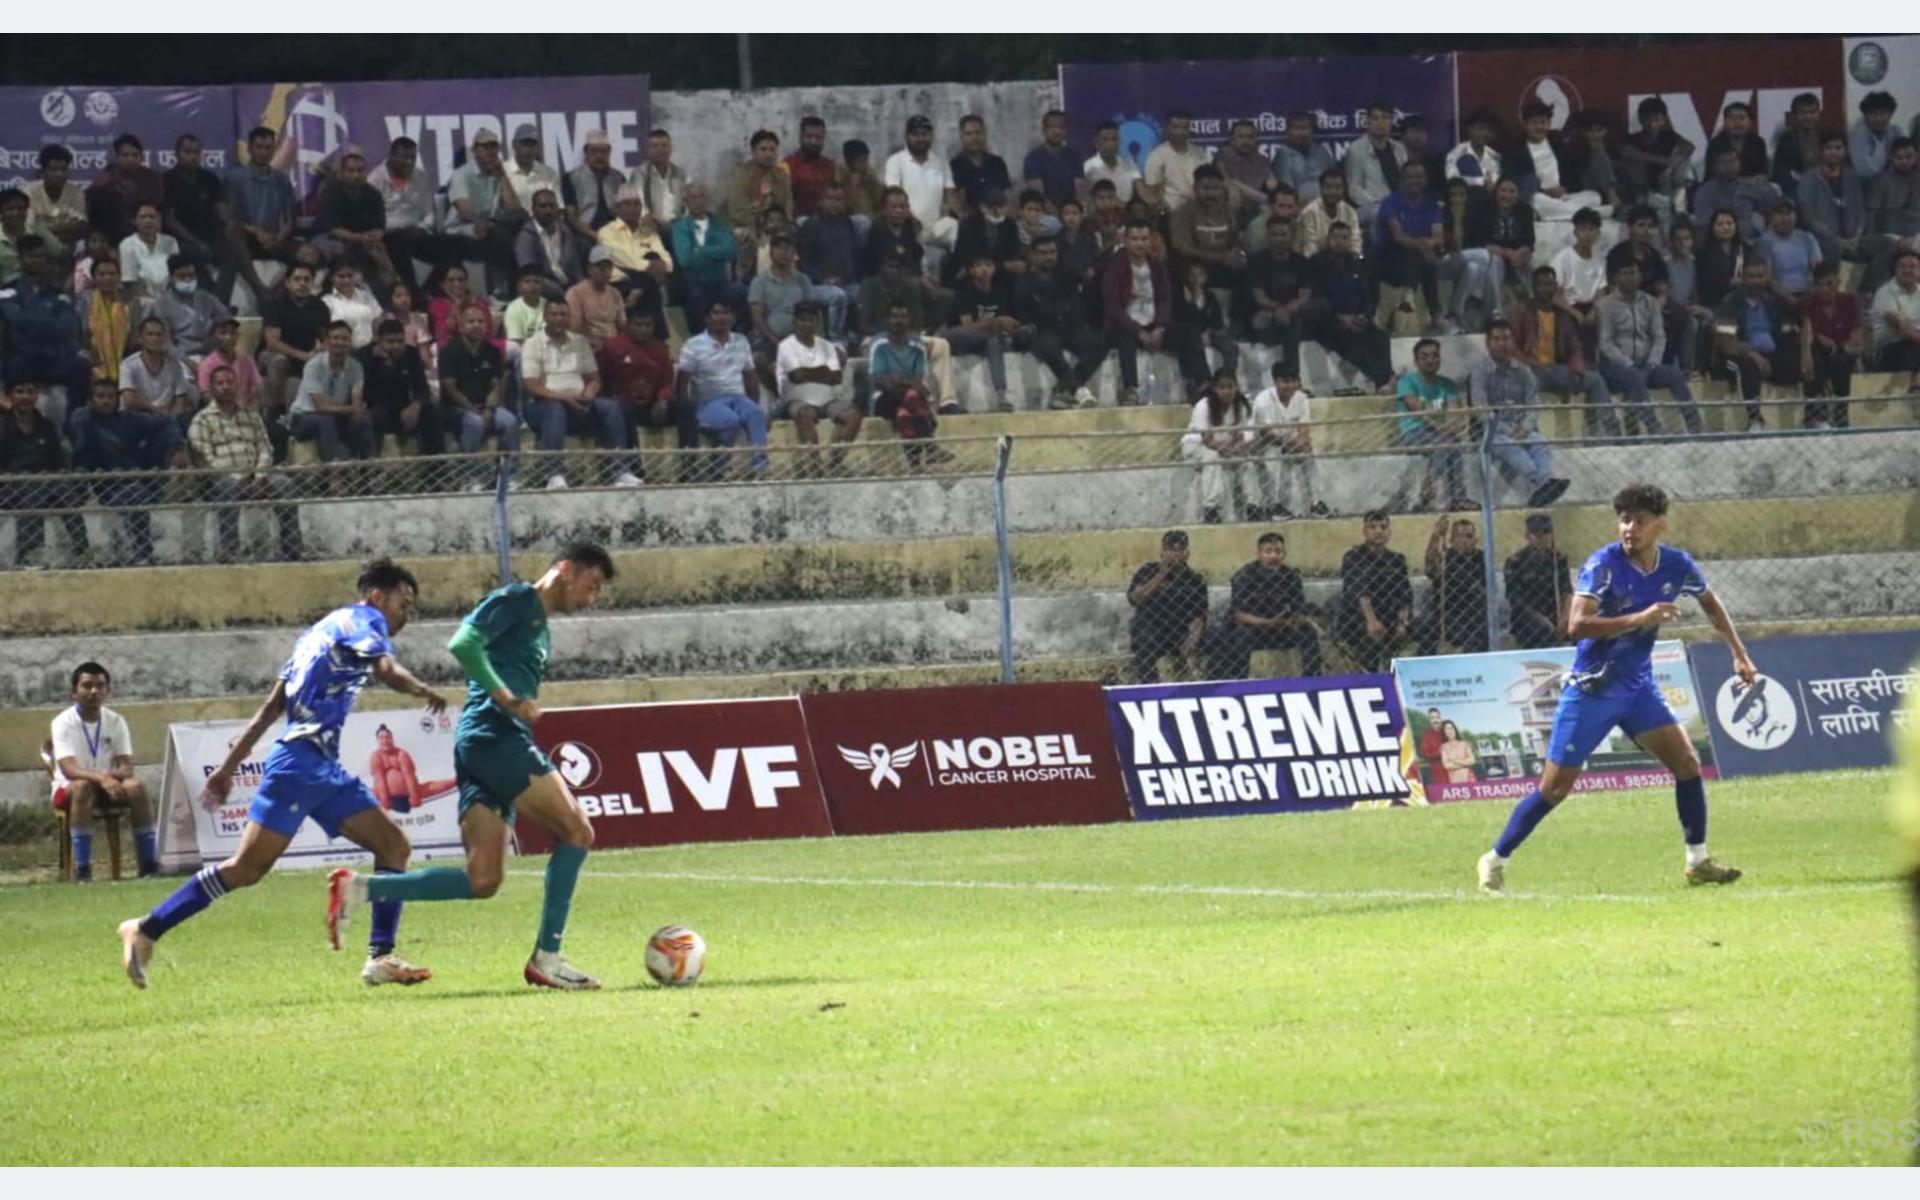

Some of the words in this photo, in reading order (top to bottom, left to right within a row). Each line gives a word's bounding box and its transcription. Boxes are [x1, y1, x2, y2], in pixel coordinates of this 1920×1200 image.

[1119, 687, 1400, 765] XTREME
[933, 734, 1093, 770] NOBEL
[576, 793, 644, 817] BEL
[636, 745, 801, 814] IVF
[938, 769, 1009, 786] CANCER
[1012, 766, 1096, 783] HOSPITAL
[1137, 762, 1280, 806] ENERGY
[1290, 755, 1410, 799] DRINK
[1442, 786, 1472, 801] ARS
[1472, 781, 1537, 798] TRADING
